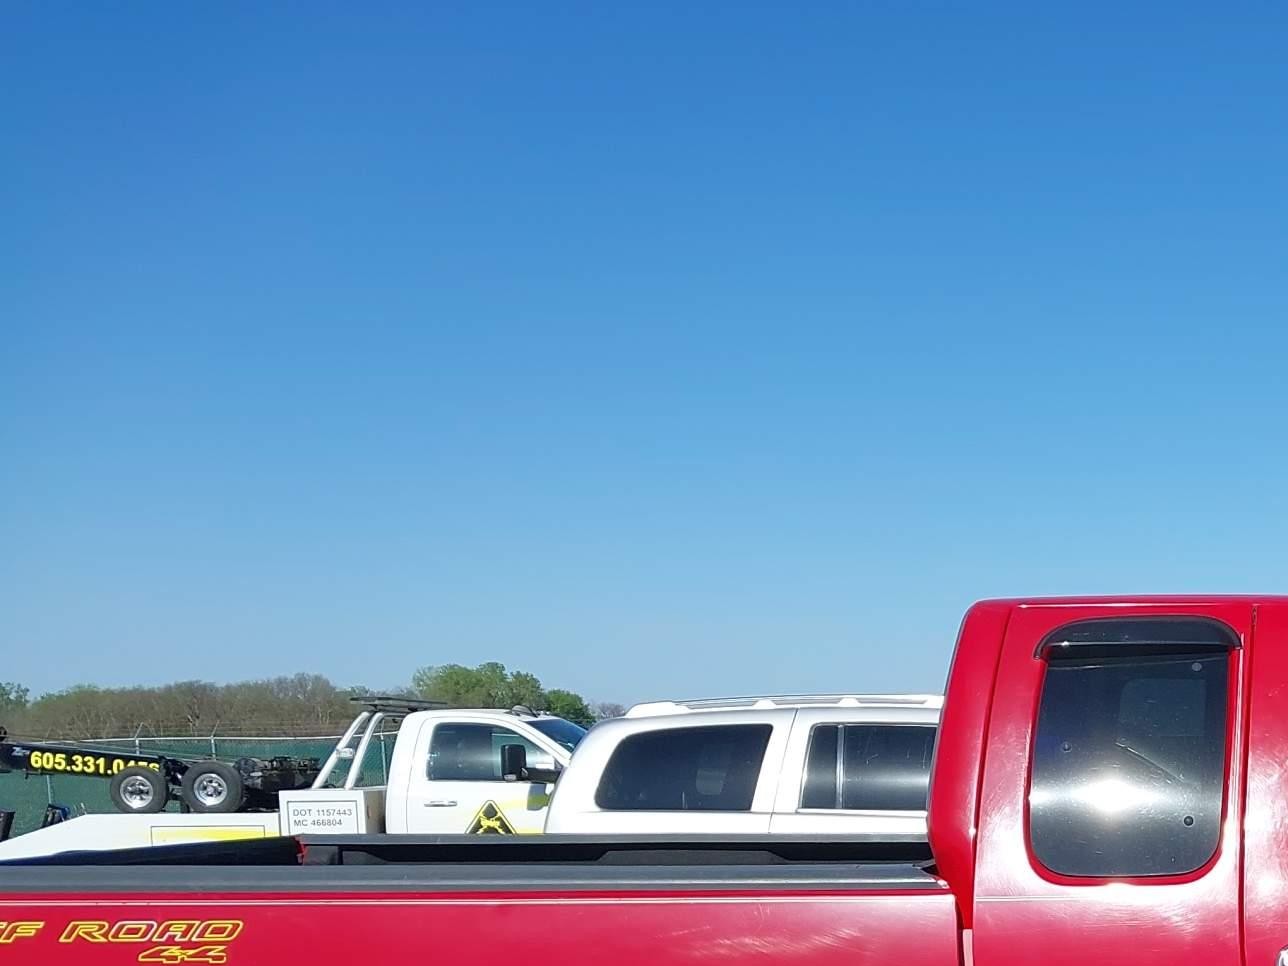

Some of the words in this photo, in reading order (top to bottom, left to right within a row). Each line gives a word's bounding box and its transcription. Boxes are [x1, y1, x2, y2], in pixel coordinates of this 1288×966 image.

[292, 808, 313, 817] DOT
[315, 808, 353, 817] 1157443
[293, 818, 309, 827] MC
[310, 818, 343, 827] 466804
[0, 920, 45, 943] F
[58, 920, 244, 942] ROAD
